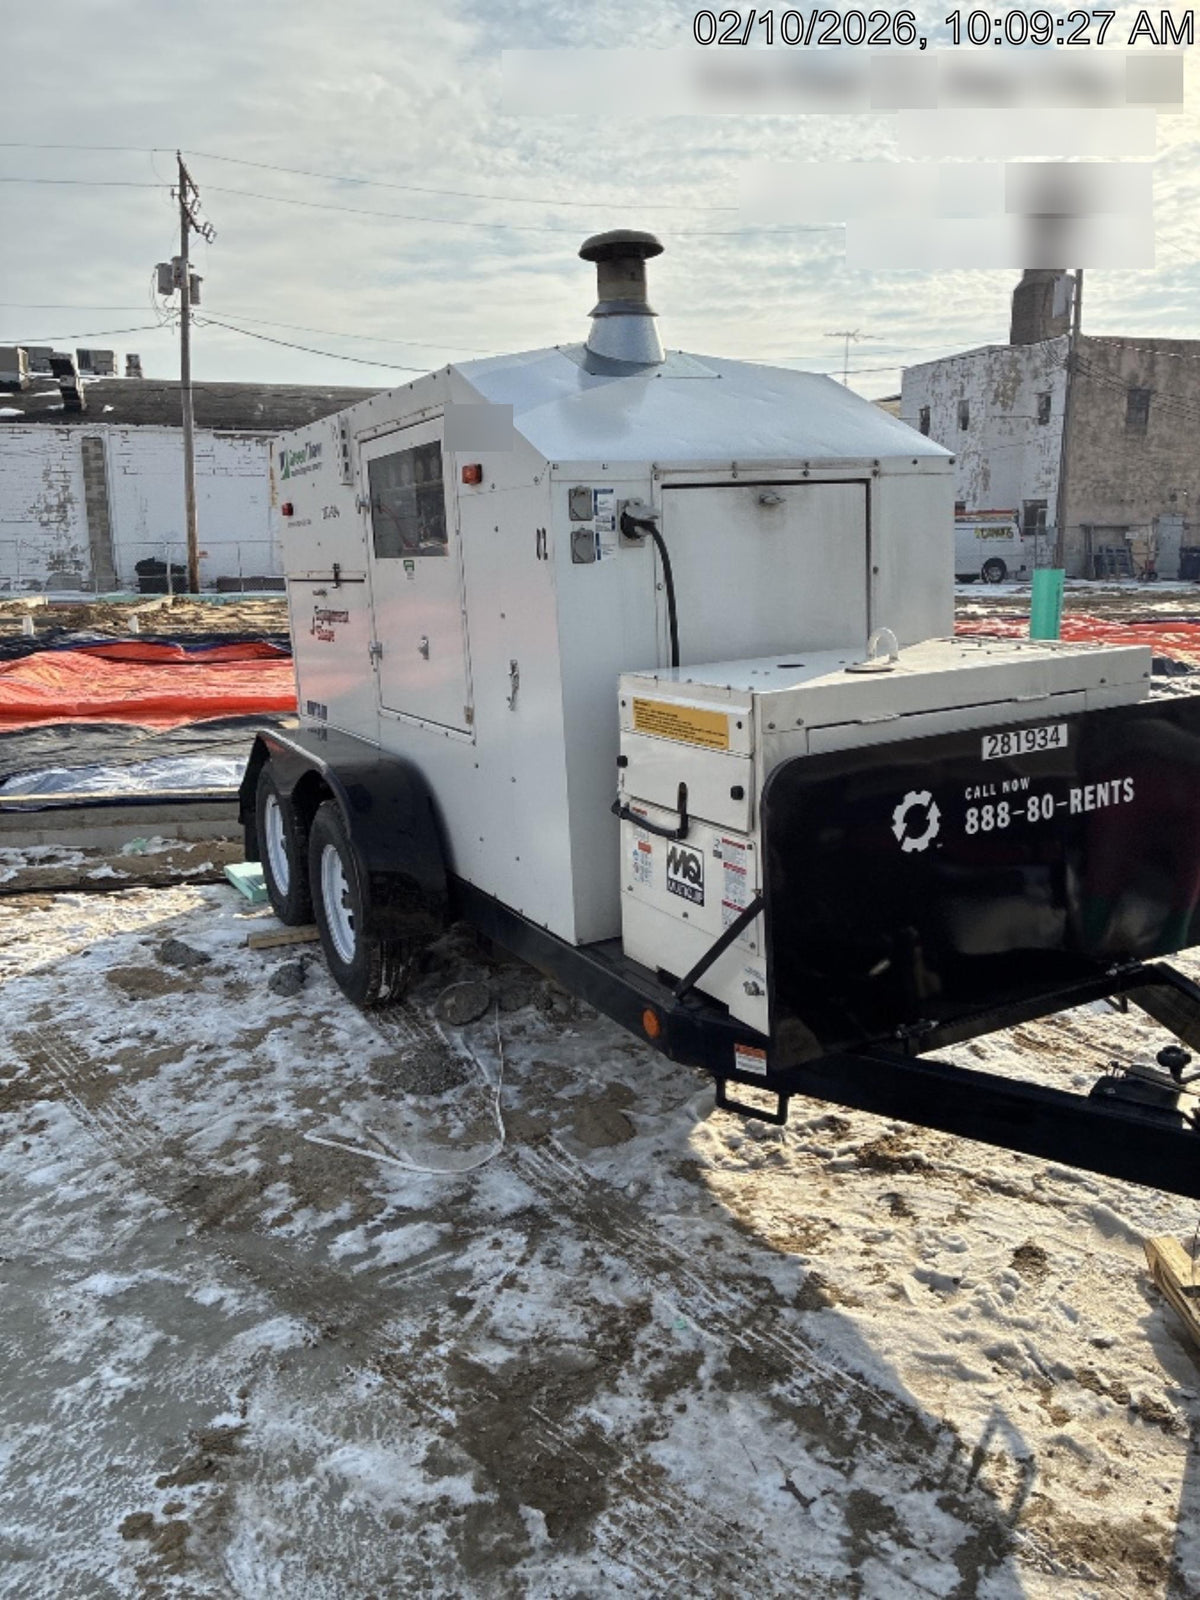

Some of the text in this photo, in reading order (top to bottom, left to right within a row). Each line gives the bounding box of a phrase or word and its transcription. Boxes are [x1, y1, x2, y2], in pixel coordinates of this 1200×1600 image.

[987, 725, 1061, 758] 281934
[965, 776, 1031, 801] CALL NOW
[965, 777, 1135, 835] 888-80-RENTS
